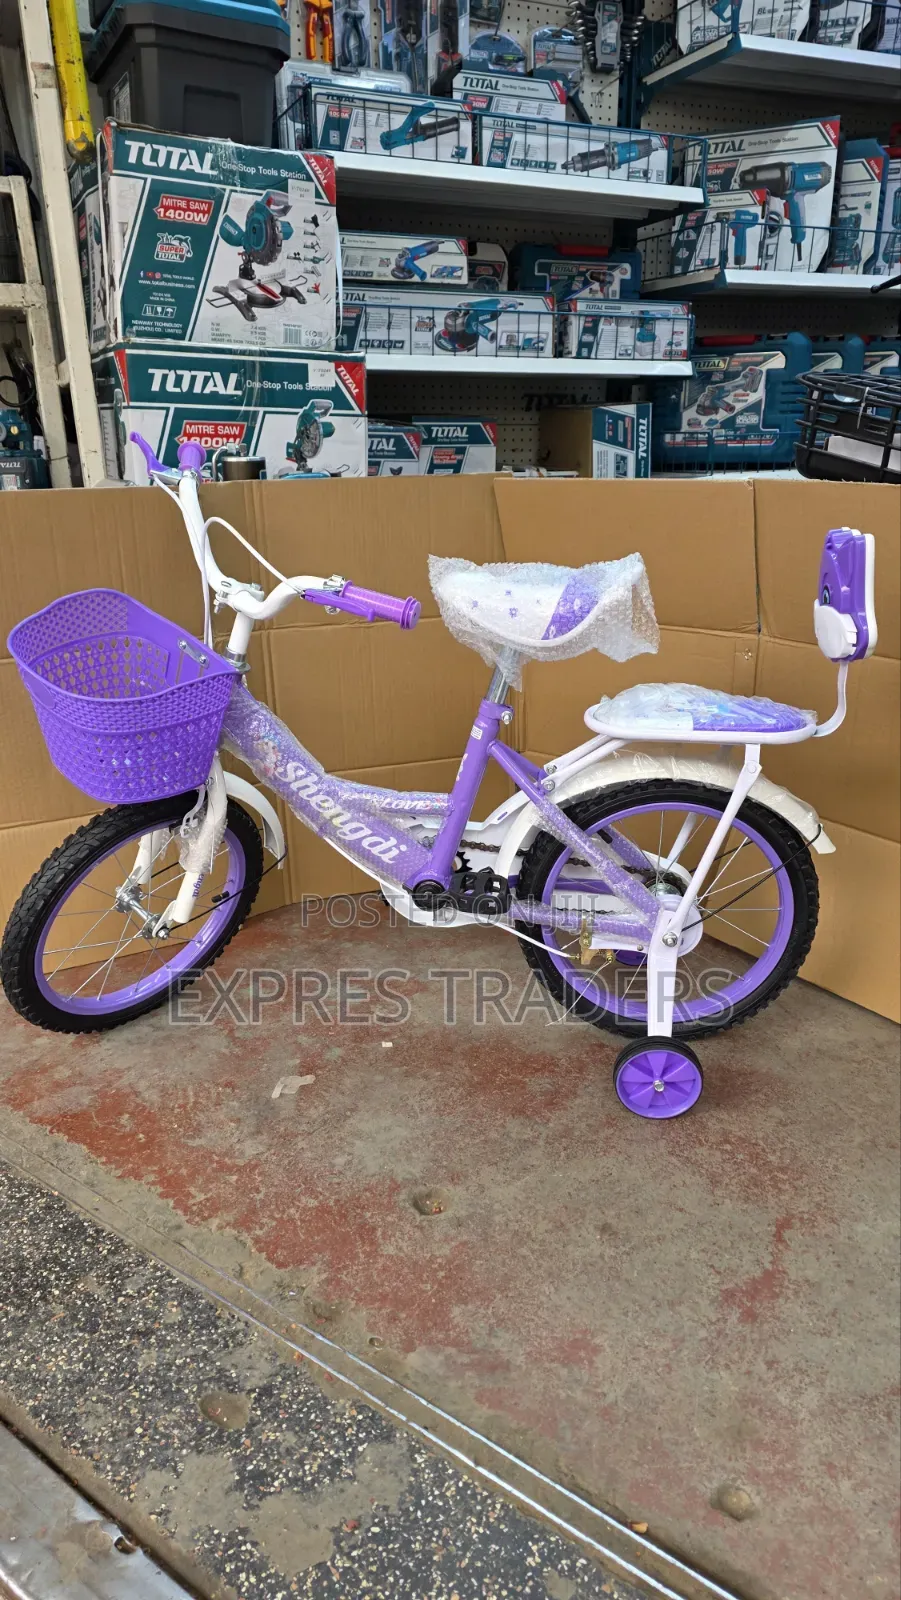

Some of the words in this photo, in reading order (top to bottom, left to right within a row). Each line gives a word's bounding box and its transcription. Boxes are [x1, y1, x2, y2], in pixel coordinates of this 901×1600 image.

[462, 75, 500, 91] TOTAL
[492, 119, 515, 128] TOTAL
[124, 139, 219, 176] TOTAL
[221, 160, 257, 174] One-Stop
[258, 165, 279, 177] Tools
[279, 168, 306, 180] Station
[308, 157, 328, 186] TOTAL
[162, 197, 188, 209] MITRE
[189, 200, 208, 211] SAW
[156, 206, 210, 225] 1400W
[157, 251, 181, 261] TOTAL
[158, 245, 185, 254] SUPER
[585, 303, 604, 311] TOTAL
[131, 319, 154, 327] NEWWAY
[693, 360, 723, 370] TOTAL
[147, 368, 243, 396] TOTAL
[245, 379, 282, 391] One-Stop
[283, 380, 304, 391] Tools
[337, 364, 360, 397] TOTAL
[185, 423, 216, 435] MITRE
[217, 424, 241, 435] SAW
[430, 426, 469, 438] TOTAL
[638, 417, 648, 460] TOTAL
[275, 760, 409, 864] Shengdi
